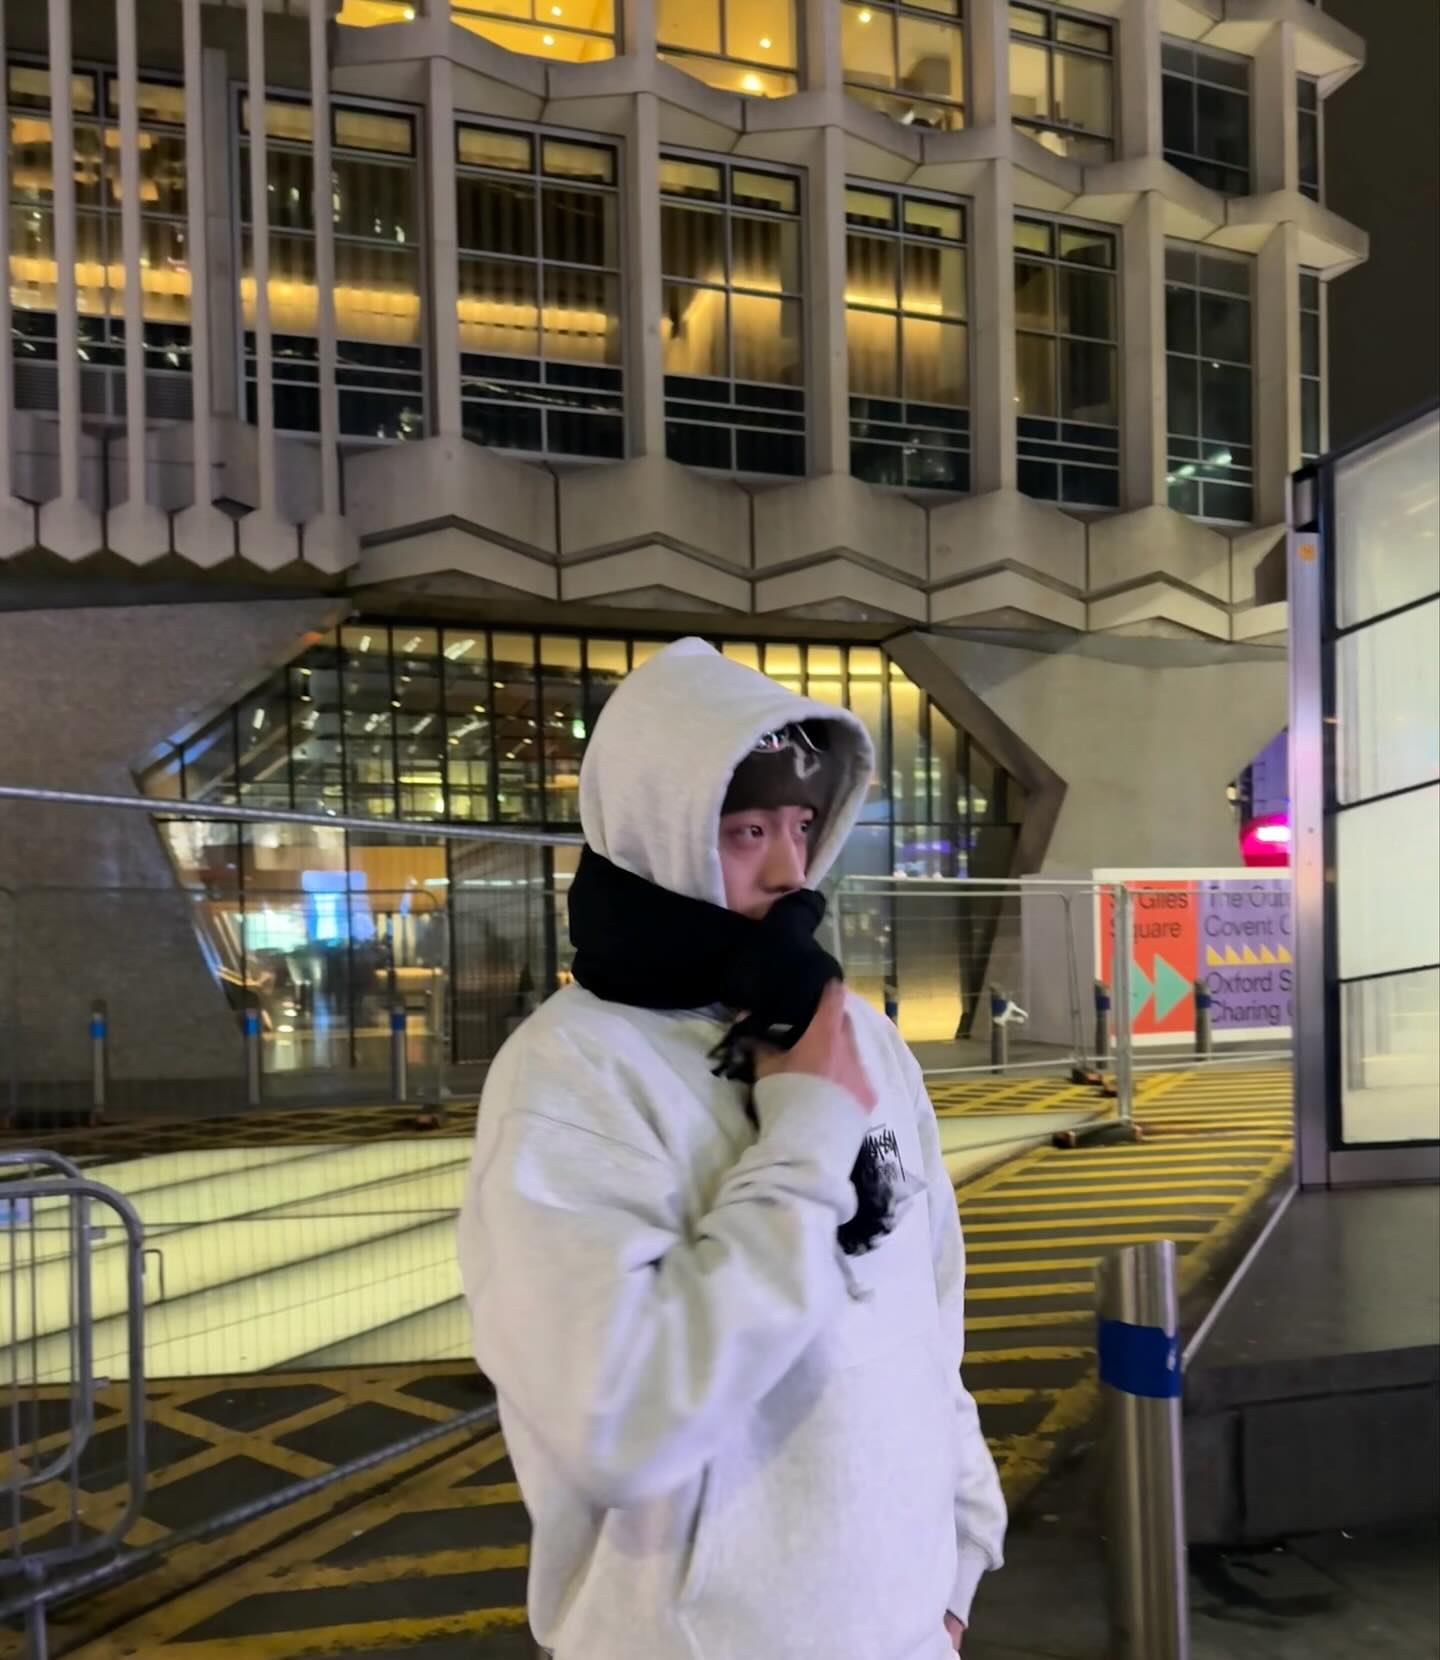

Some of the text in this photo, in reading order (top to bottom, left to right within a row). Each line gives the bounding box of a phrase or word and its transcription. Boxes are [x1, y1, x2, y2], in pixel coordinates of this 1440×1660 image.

[1138, 886, 1188, 910] Giles
[1110, 919, 1181, 944] uare
[1204, 914, 1273, 937] Covent
[1206, 970, 1273, 994] Oxford
